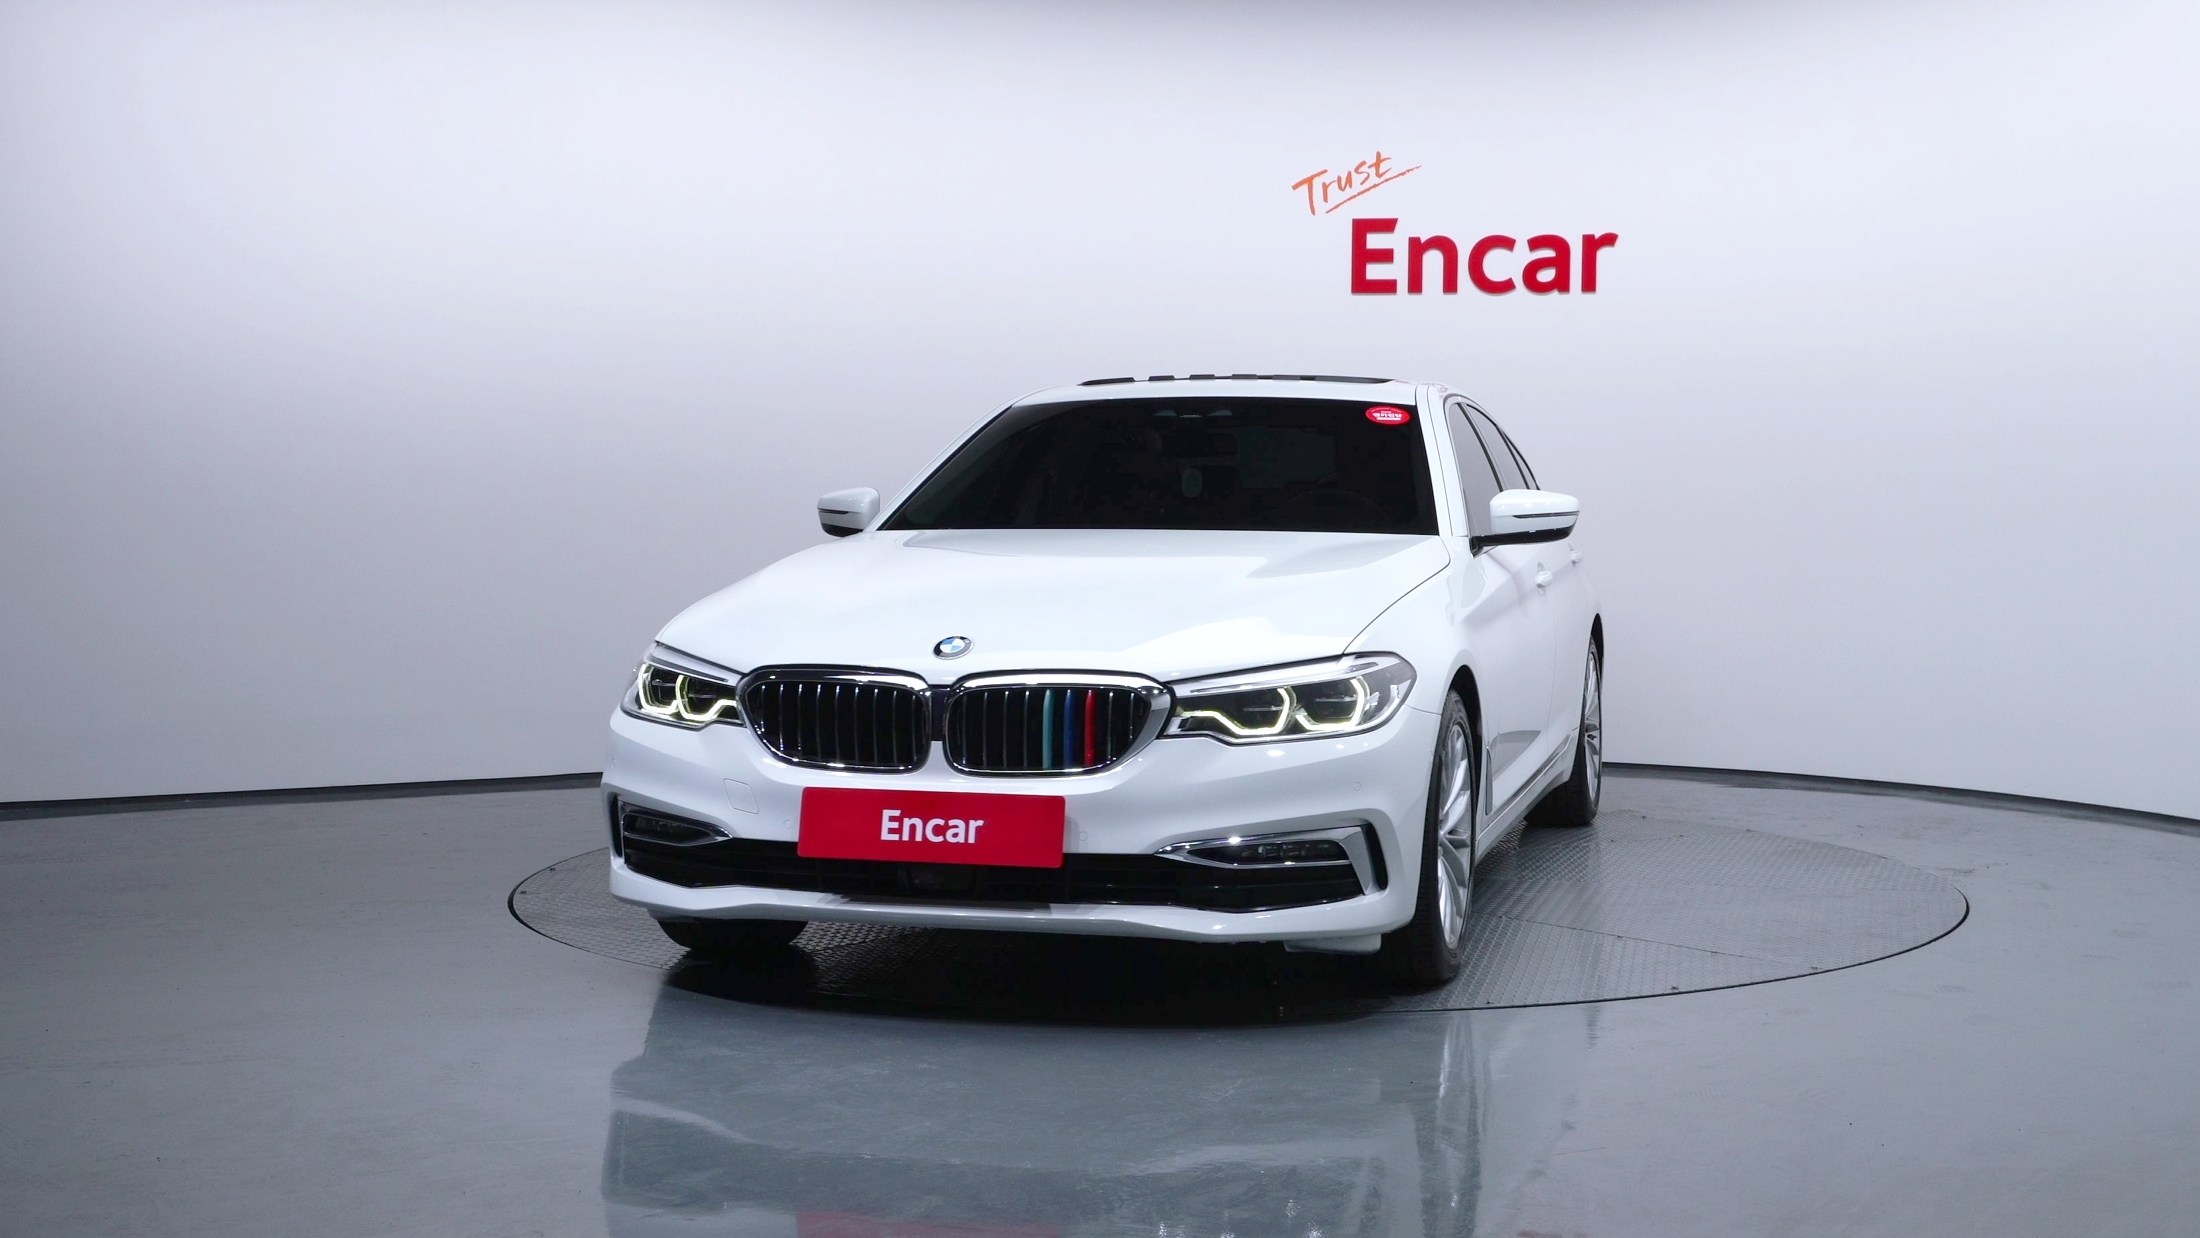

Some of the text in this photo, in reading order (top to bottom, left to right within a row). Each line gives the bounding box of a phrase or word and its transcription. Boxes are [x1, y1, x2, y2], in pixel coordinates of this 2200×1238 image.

[1291, 150, 1392, 215] Trust
[1351, 217, 1619, 295] Encar
[880, 808, 985, 844] Encar
